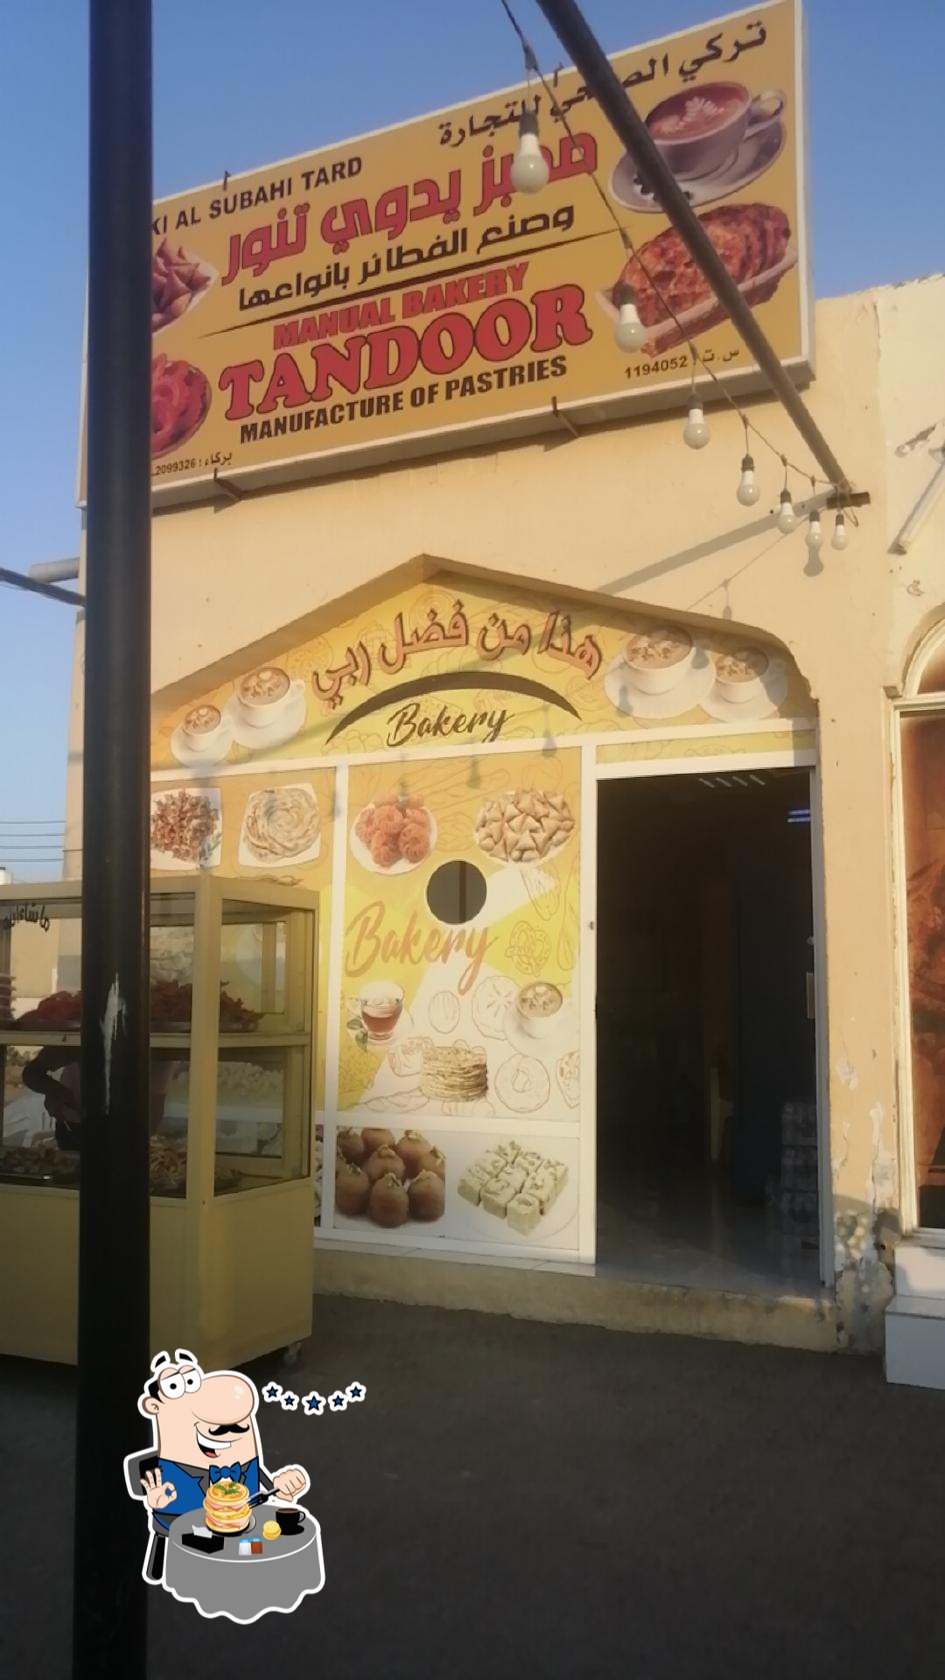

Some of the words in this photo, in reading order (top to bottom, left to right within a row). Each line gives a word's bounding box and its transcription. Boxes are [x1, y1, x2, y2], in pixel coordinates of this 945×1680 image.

[678, 20, 767, 82] تركي
[438, 94, 541, 148] للتجارة
[550, 52, 669, 123] الصحي
[175, 206, 202, 230] AL
[208, 177, 293, 220] SUBAHI
[300, 156, 363, 192] TARD
[221, 202, 311, 287] تنور
[357, 227, 468, 286] الفطائر
[476, 205, 575, 255] وصنع
[238, 262, 350, 313] بانواعها
[273, 297, 396, 351] MANUAL
[402, 261, 530, 320] BAKERY
[218, 284, 593, 421] TANDOOR
[624, 355, 688, 379] 1194052
[240, 391, 404, 444] MANUFACTURE
[410, 383, 439, 408] OF
[445, 355, 567, 400] PASTRIES
[377, 599, 470, 675] فضل
[477, 612, 532, 662] من
[538, 609, 603, 680] هذا
[311, 640, 372, 710] ربي
[386, 702, 515, 747] Bakery
[344, 900, 499, 996] Bakery
